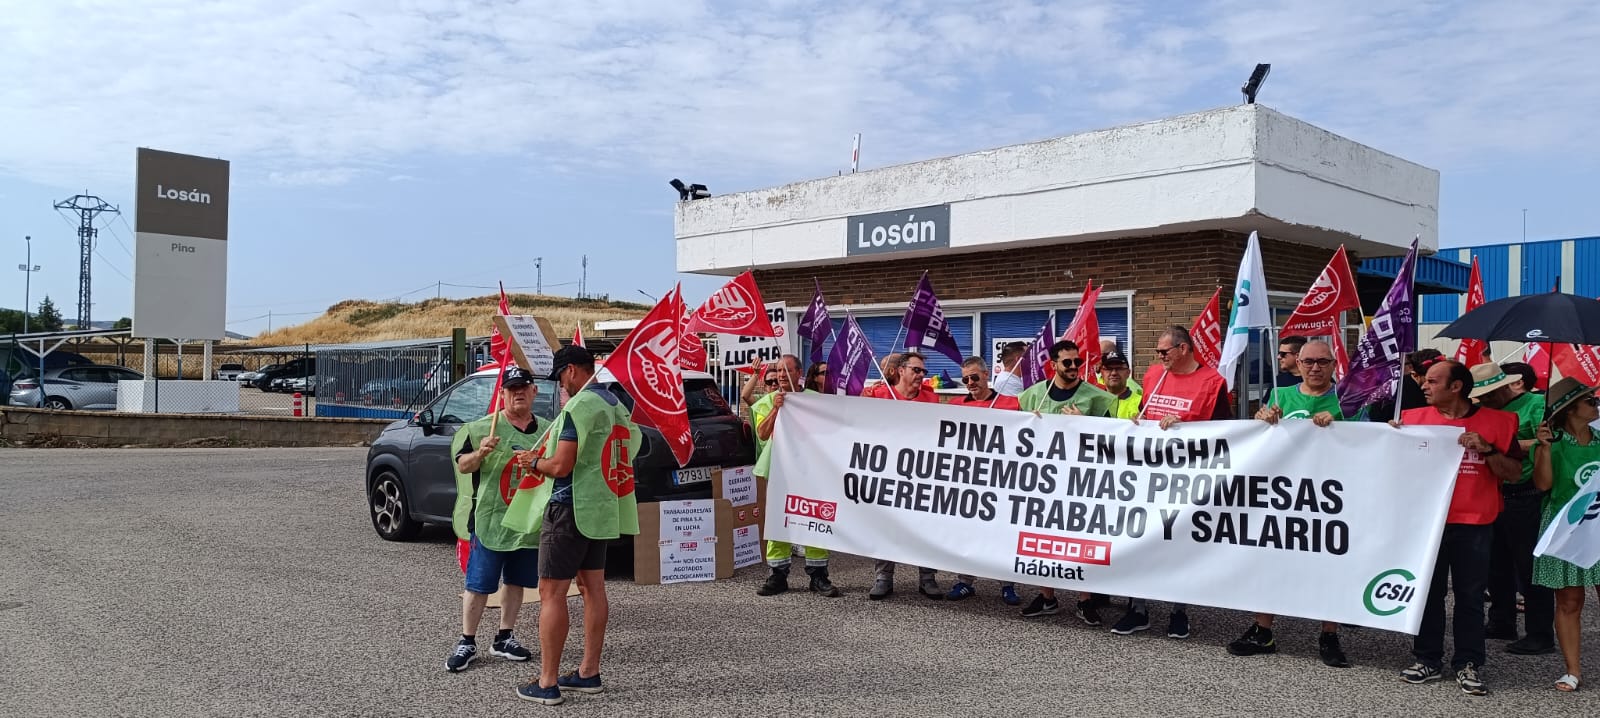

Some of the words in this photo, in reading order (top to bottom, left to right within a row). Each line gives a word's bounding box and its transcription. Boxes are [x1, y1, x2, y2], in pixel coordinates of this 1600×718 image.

[157, 184, 211, 204] Losán
[858, 214, 936, 248] Losán
[171, 243, 196, 253] Pina
[725, 346, 782, 367] LUCHA
[938, 420, 1006, 454] PINA
[1016, 428, 1066, 461] S.A
[1077, 433, 1116, 464] EN
[1126, 436, 1231, 469] LUCHA
[678, 470, 703, 483] 2793
[849, 442, 888, 473] NO
[896, 448, 1058, 494] QUEREMOS
[1067, 467, 1138, 502] MAS
[1147, 472, 1343, 515] PROMESAS
[787, 497, 819, 516] UGT
[843, 472, 998, 522] QUEREMOS
[1008, 495, 1148, 539] TRABAJO
[1160, 509, 1180, 540] Y
[1191, 510, 1349, 555] SALARIO
[808, 521, 833, 535] FICA
[1021, 537, 1081, 557] CCOO
[1014, 557, 1084, 580] hábitat
